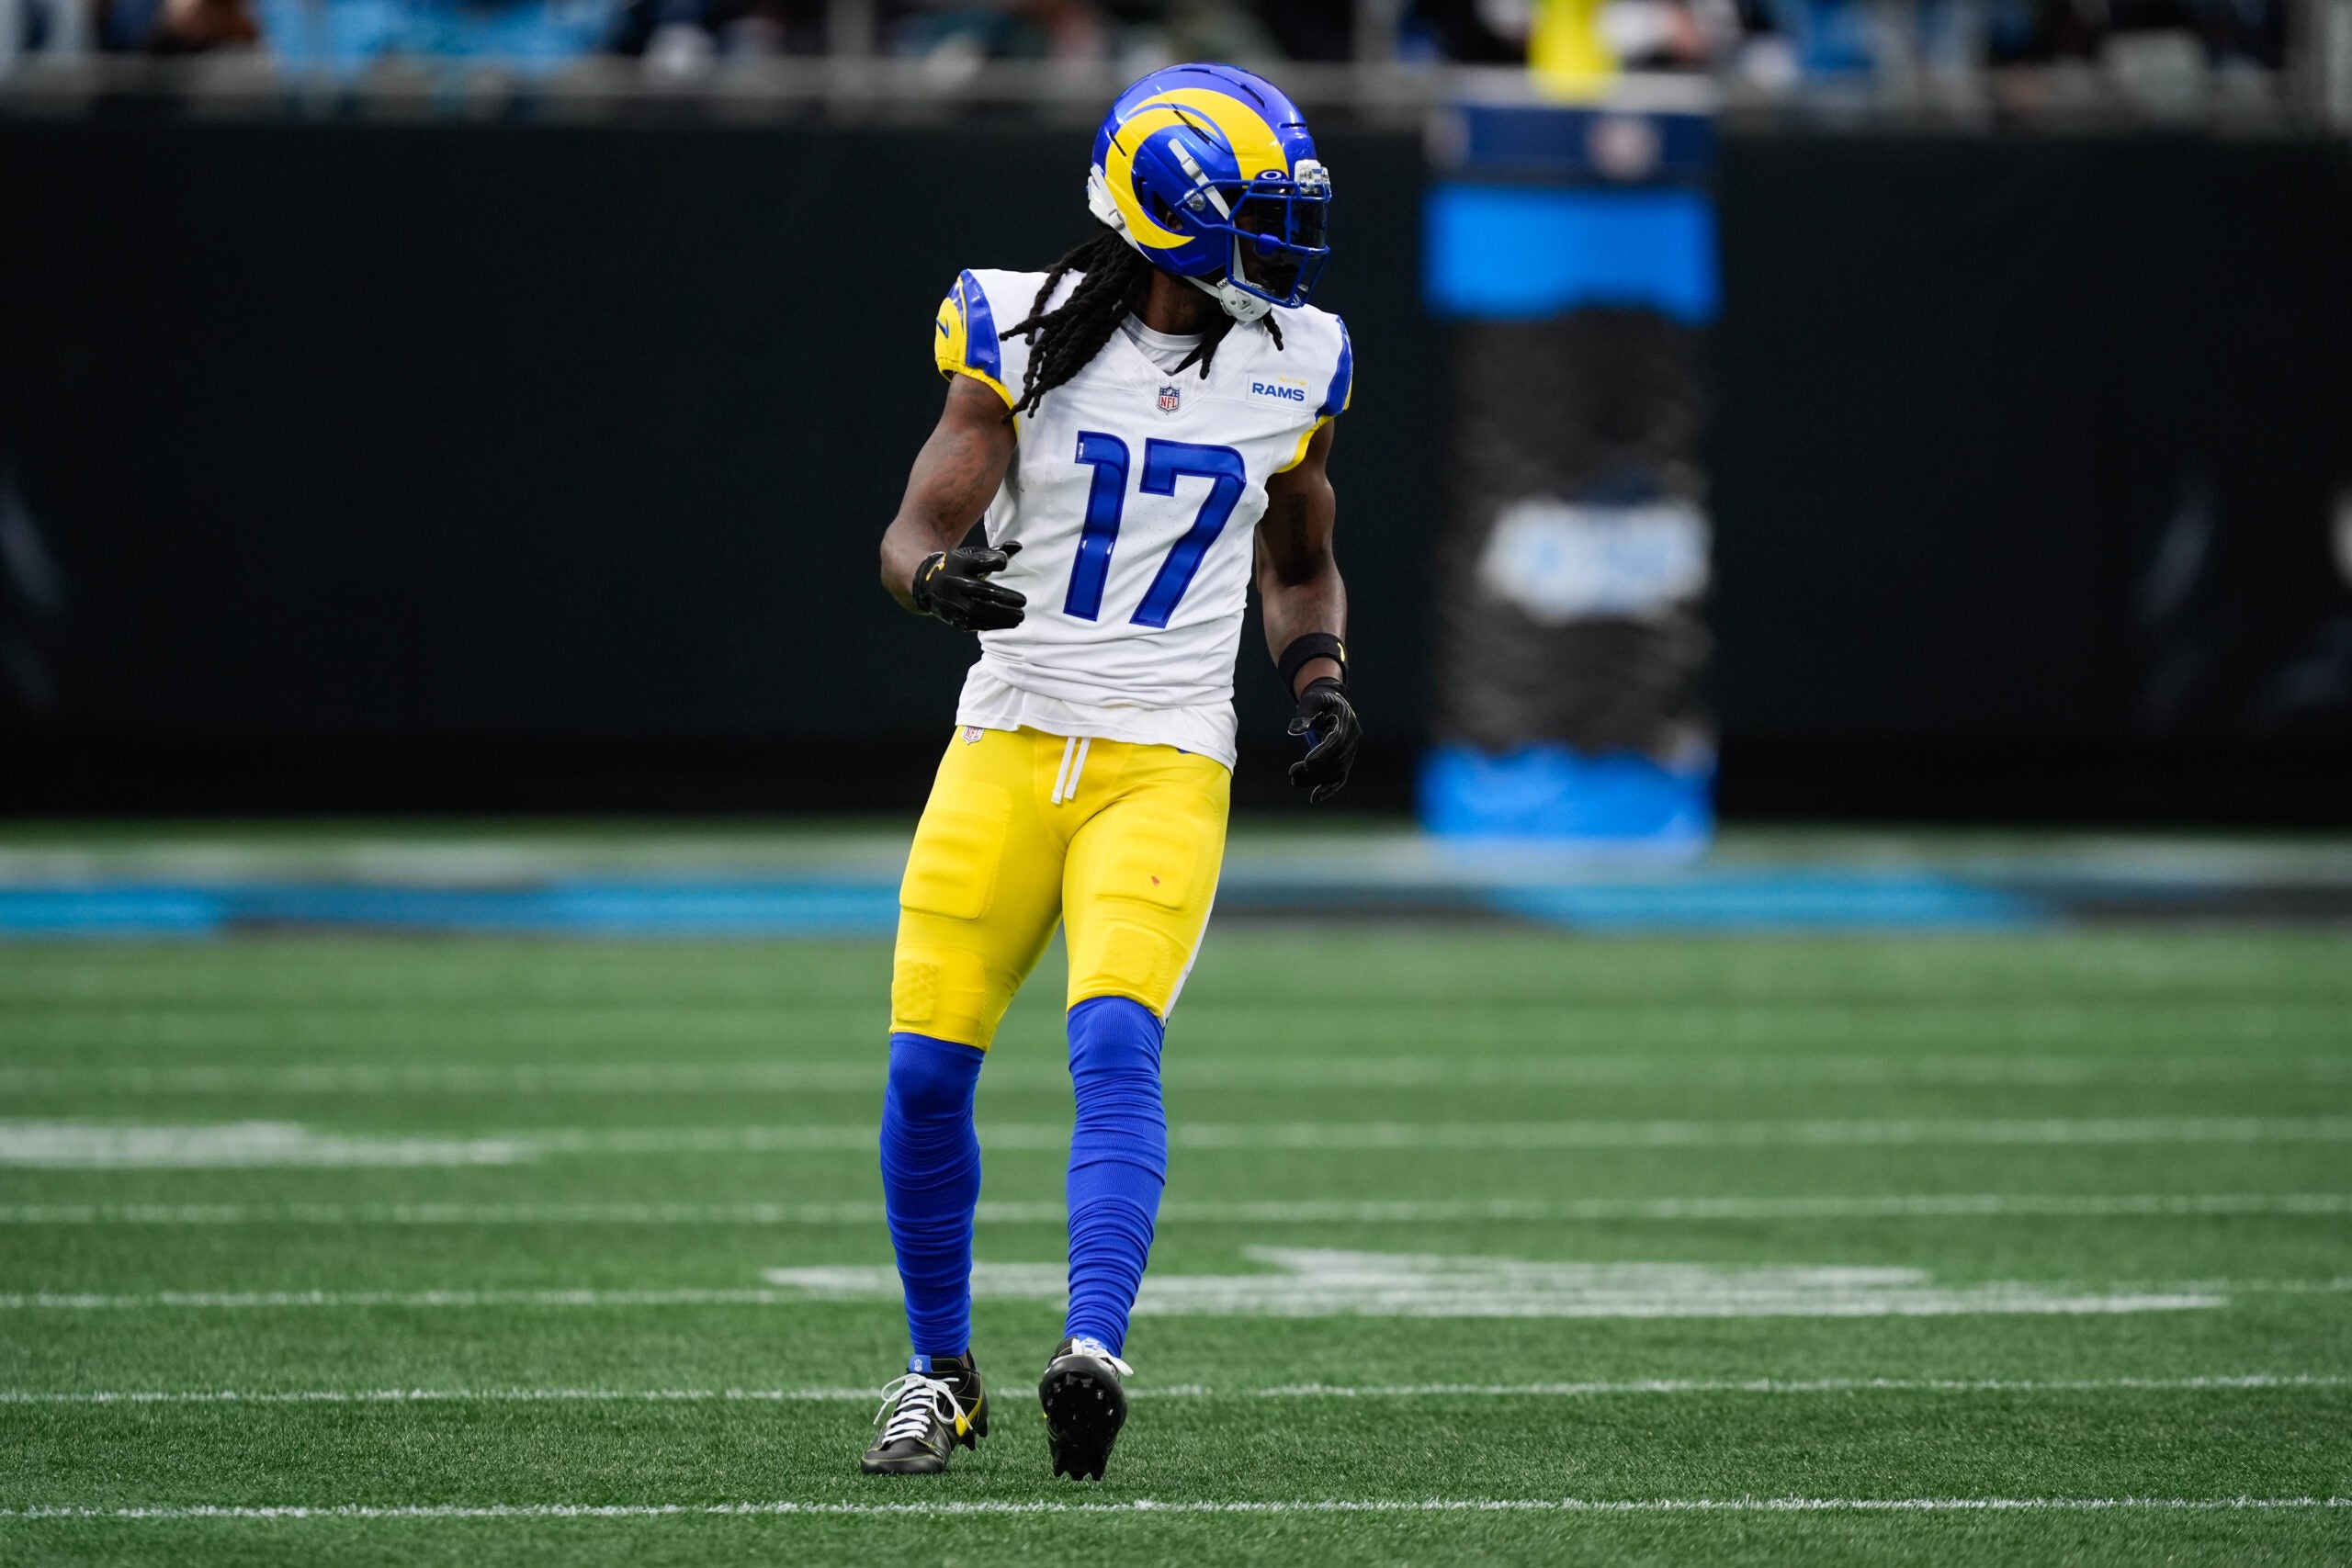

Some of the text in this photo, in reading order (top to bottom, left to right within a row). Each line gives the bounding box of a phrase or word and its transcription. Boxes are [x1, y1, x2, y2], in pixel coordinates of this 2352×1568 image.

[1252, 382, 1306, 401] RAMS
[1160, 396, 1177, 409] NFL
[1064, 430, 1246, 628] 17
